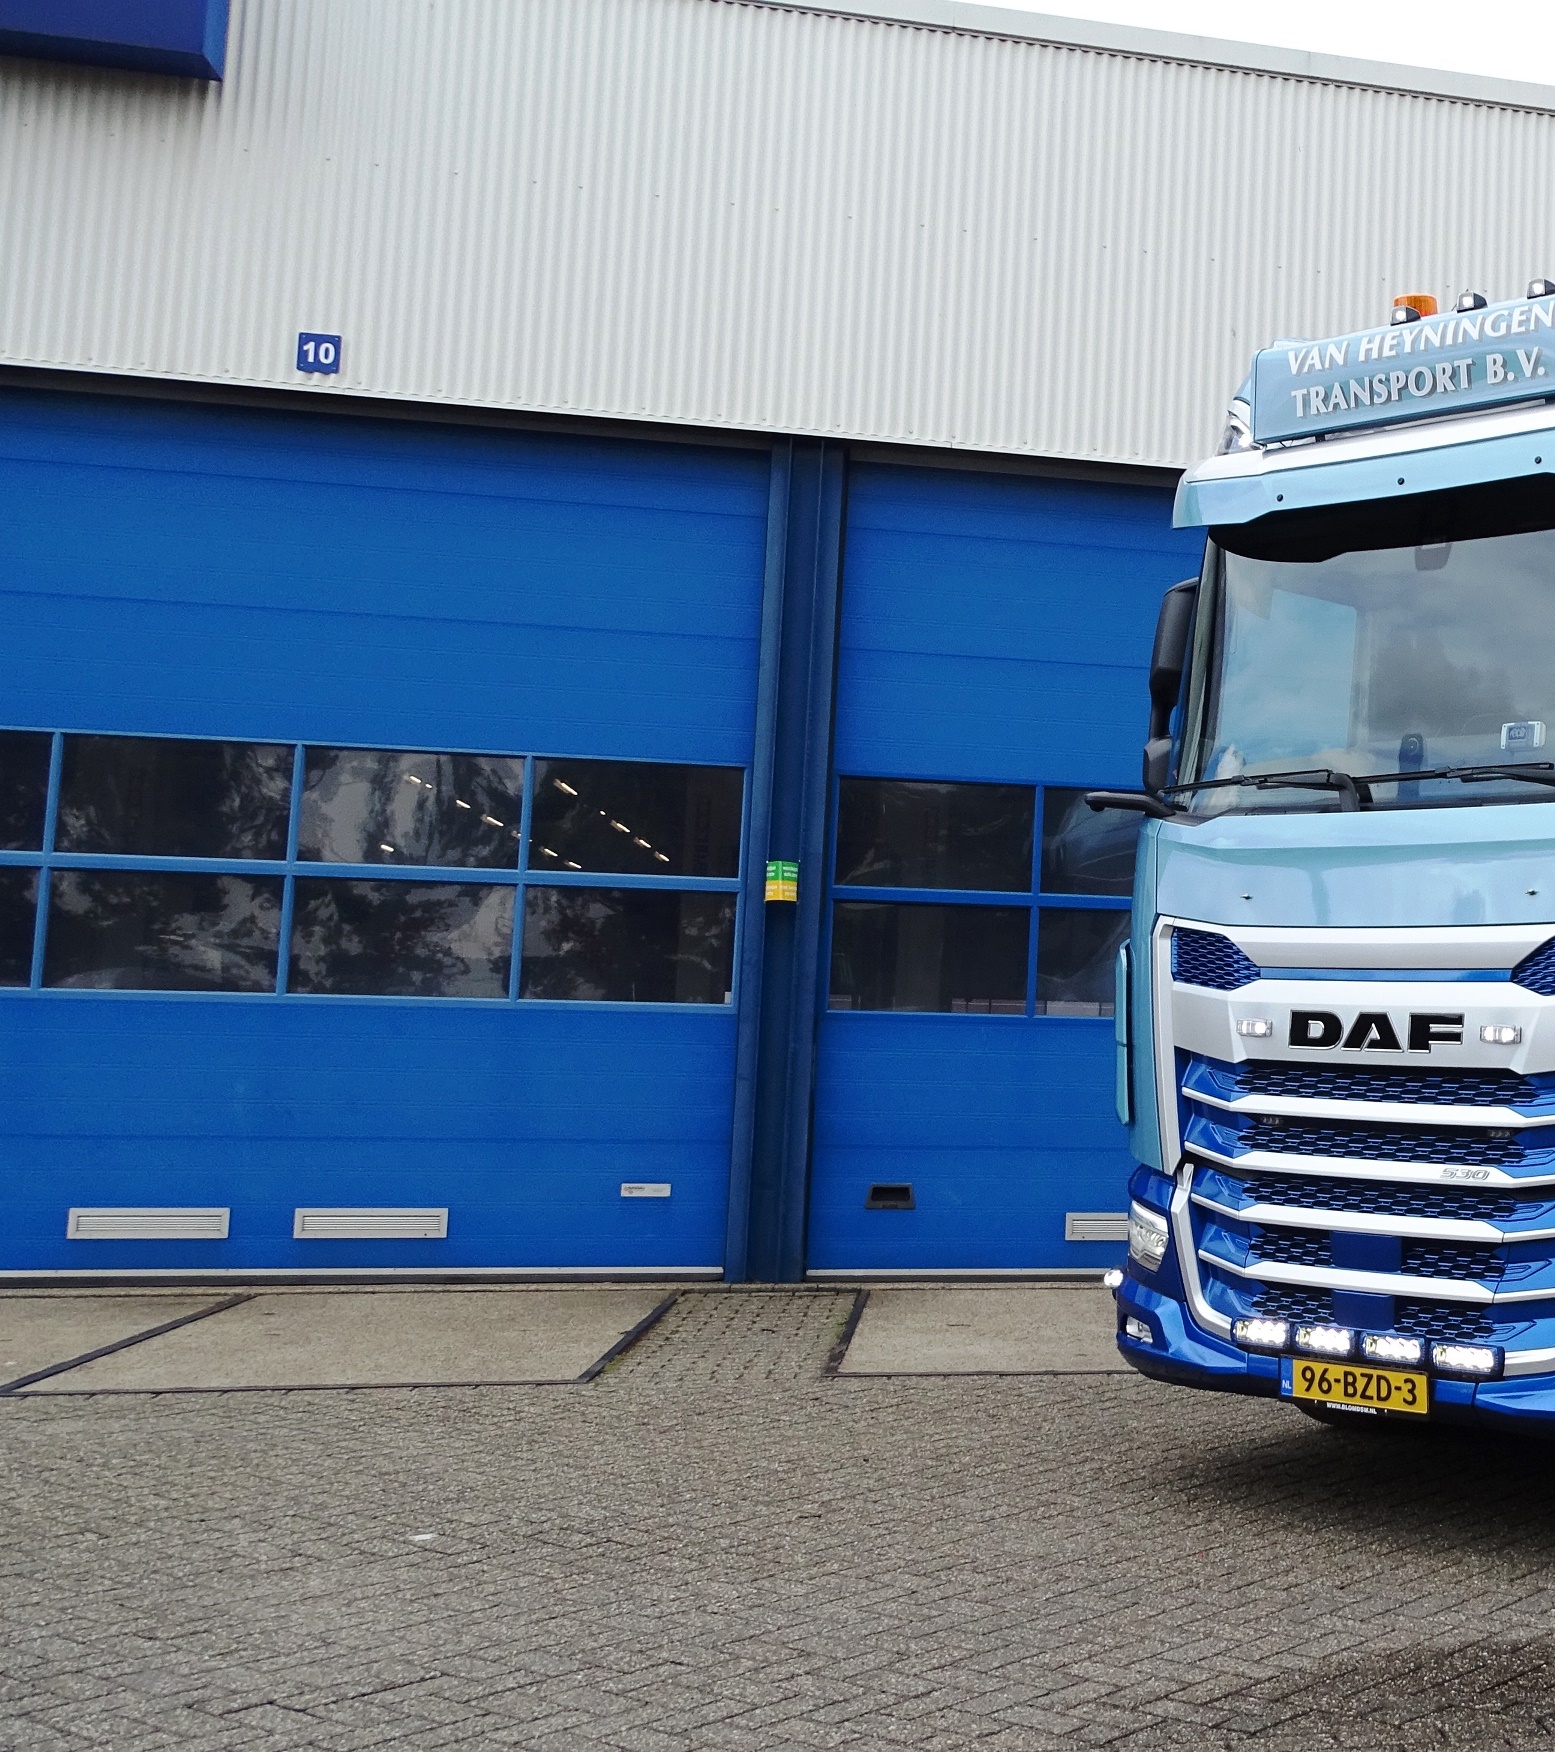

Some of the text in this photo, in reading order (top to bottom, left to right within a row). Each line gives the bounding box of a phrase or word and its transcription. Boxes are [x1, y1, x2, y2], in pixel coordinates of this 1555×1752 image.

[303, 341, 336, 365] 10
[1287, 340, 1351, 376] VAN
[1291, 358, 1474, 418] TRANSPORT
[1288, 1009, 1466, 1054] DAF
[1440, 1166, 1490, 1181] 530
[1282, 1365, 1418, 1406] NL 96-BZD-3
